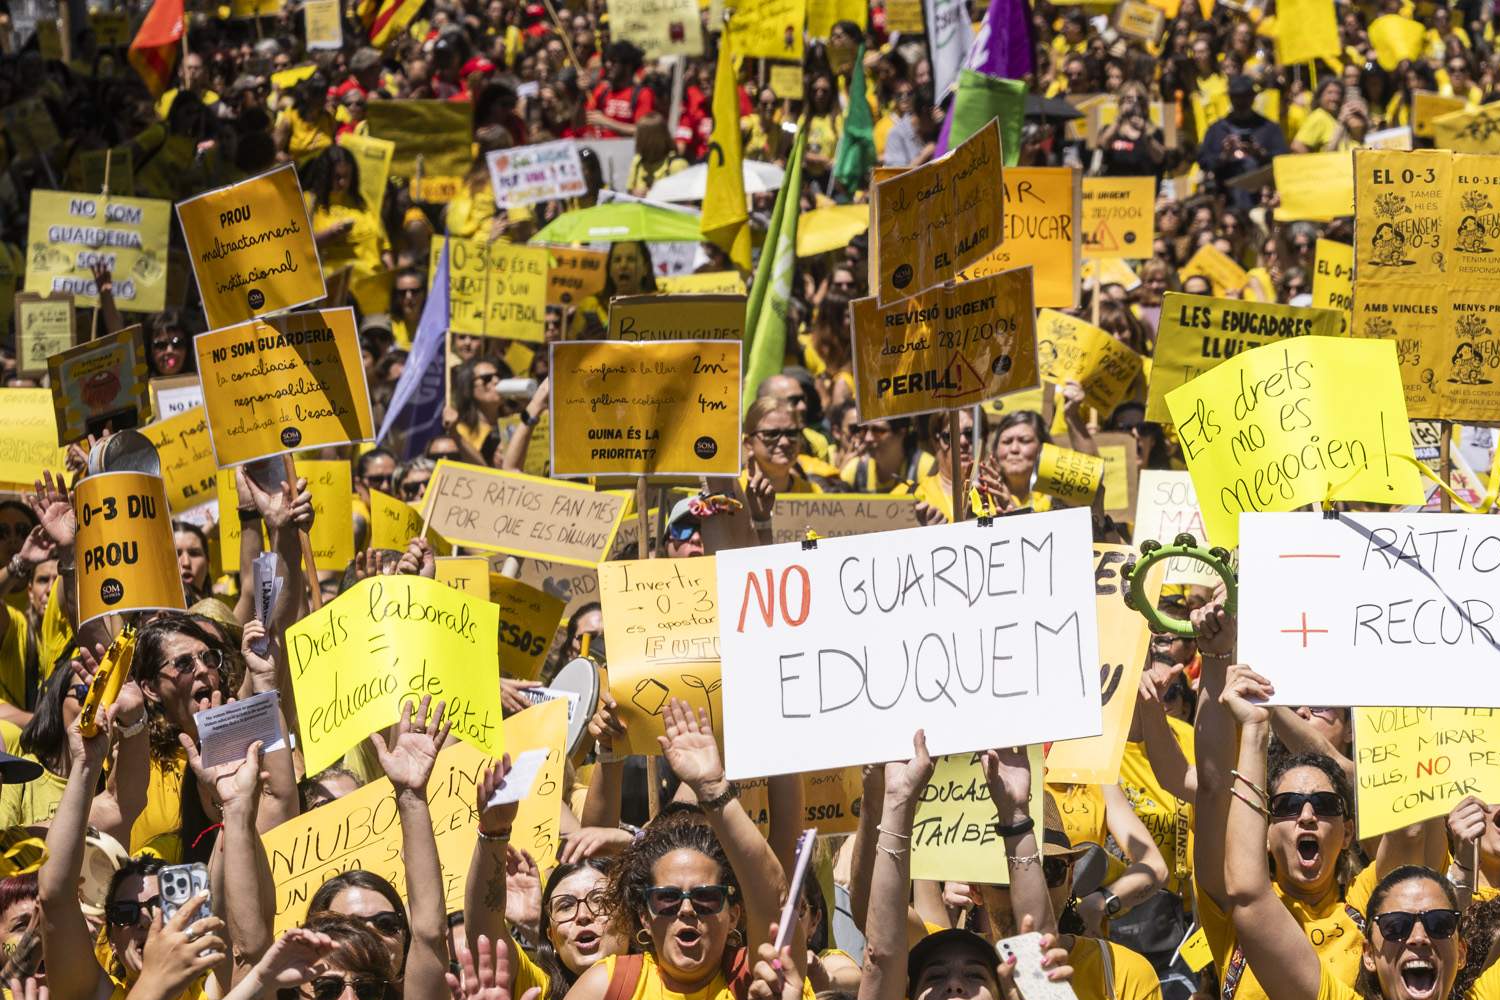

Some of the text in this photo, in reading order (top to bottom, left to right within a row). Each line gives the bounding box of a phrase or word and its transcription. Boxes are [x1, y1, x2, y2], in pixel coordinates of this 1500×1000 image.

[1373, 168, 1436, 184] EL 0-3
[1458, 176, 1469, 184] EL
[70, 199, 142, 224] NO SOM
[219, 205, 251, 229] PROU
[49, 226, 142, 249] GUARDERIA
[201, 219, 300, 262] maltractament
[1412, 234, 1440, 248] 0-3
[77, 251, 116, 271] SOM
[217, 250, 298, 294] institucional
[934, 252, 951, 270] EL
[1317, 258, 1334, 275] EL
[884, 296, 998, 328] REVISIÓ URGENT
[1180, 304, 1315, 338] LES EDUCADORES
[1364, 303, 1438, 314] AMB VINCLES
[1452, 303, 1486, 312] MENYS
[212, 327, 336, 364] NO SOM GUARDERIA
[881, 317, 1018, 356] decret 282/2006
[231, 358, 298, 382] conciliació
[876, 362, 964, 399] PERILL!
[234, 378, 331, 415] responsabilitat
[1178, 348, 1315, 462] Els drets
[294, 404, 350, 423] l'escola
[1279, 397, 1312, 433] es
[588, 425, 661, 441] QUINA ÉS LA
[591, 448, 657, 461] PRIORITAT?
[1220, 434, 1370, 517] negocien
[83, 494, 157, 525] 0-3 DIU
[440, 473, 618, 525] LES RÀTIOS FAN MÉS
[855, 502, 877, 519] AL
[446, 506, 478, 531] POR
[493, 518, 527, 545] QUE
[530, 521, 554, 540] ELS
[555, 521, 608, 551] DILLUNS
[84, 540, 139, 575] PROU
[102, 584, 121, 596] SOM
[617, 562, 704, 594] Invertir
[736, 531, 1055, 635] NO GUARDEM
[293, 581, 478, 681] Drets laborals
[778, 610, 1088, 721] EDUQUEM
[308, 657, 399, 744] educació
[408, 658, 444, 696] de
[1358, 743, 1401, 765] PER
[1417, 728, 1487, 755] MIRAR
[1416, 755, 1451, 779] NO
[1392, 777, 1483, 814] CONTAR
[1310, 922, 1345, 946] 0-3
